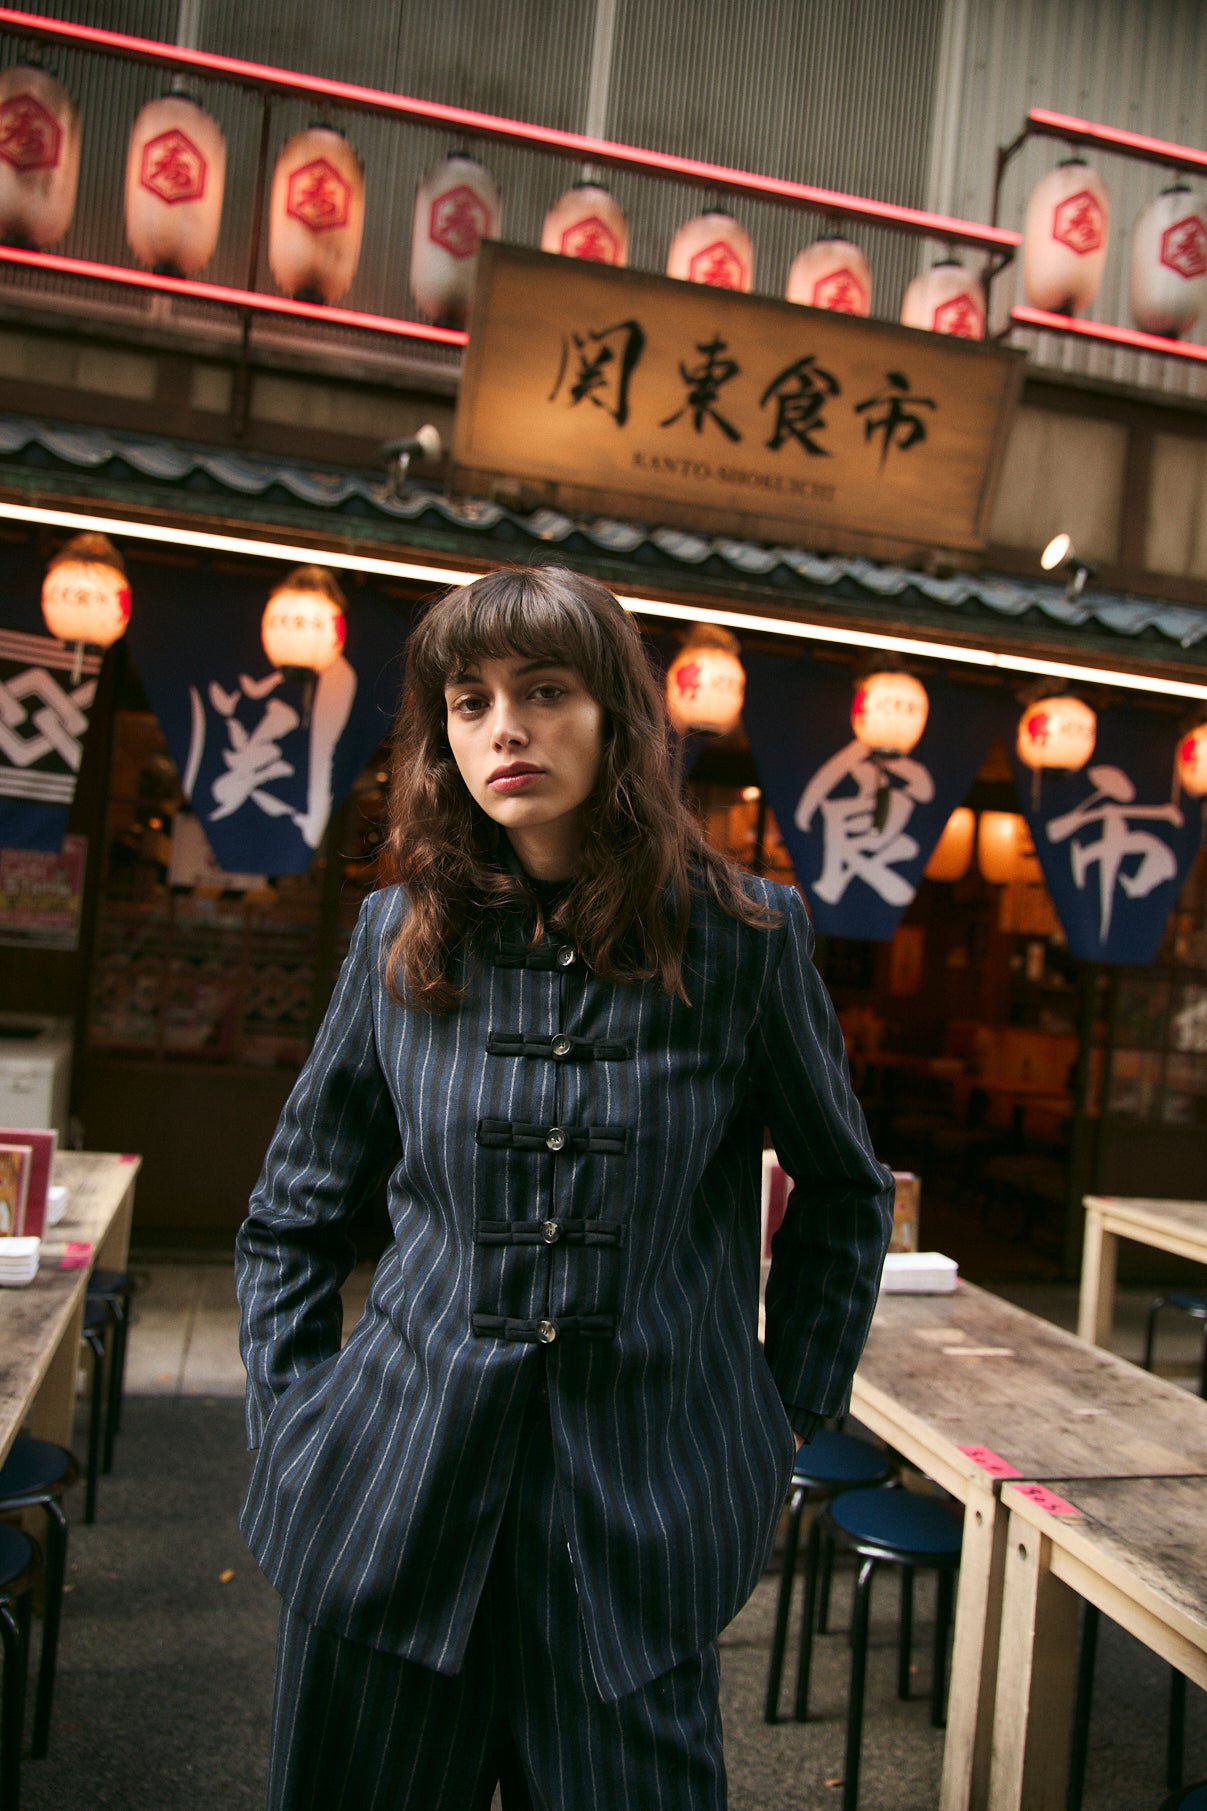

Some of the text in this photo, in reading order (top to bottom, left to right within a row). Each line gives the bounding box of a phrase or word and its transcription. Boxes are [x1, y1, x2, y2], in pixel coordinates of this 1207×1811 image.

[549, 319, 937, 475] 関東食市
[184, 655, 358, 850] 関
[794, 737, 936, 907] 食
[1046, 764, 1185, 944] 市
